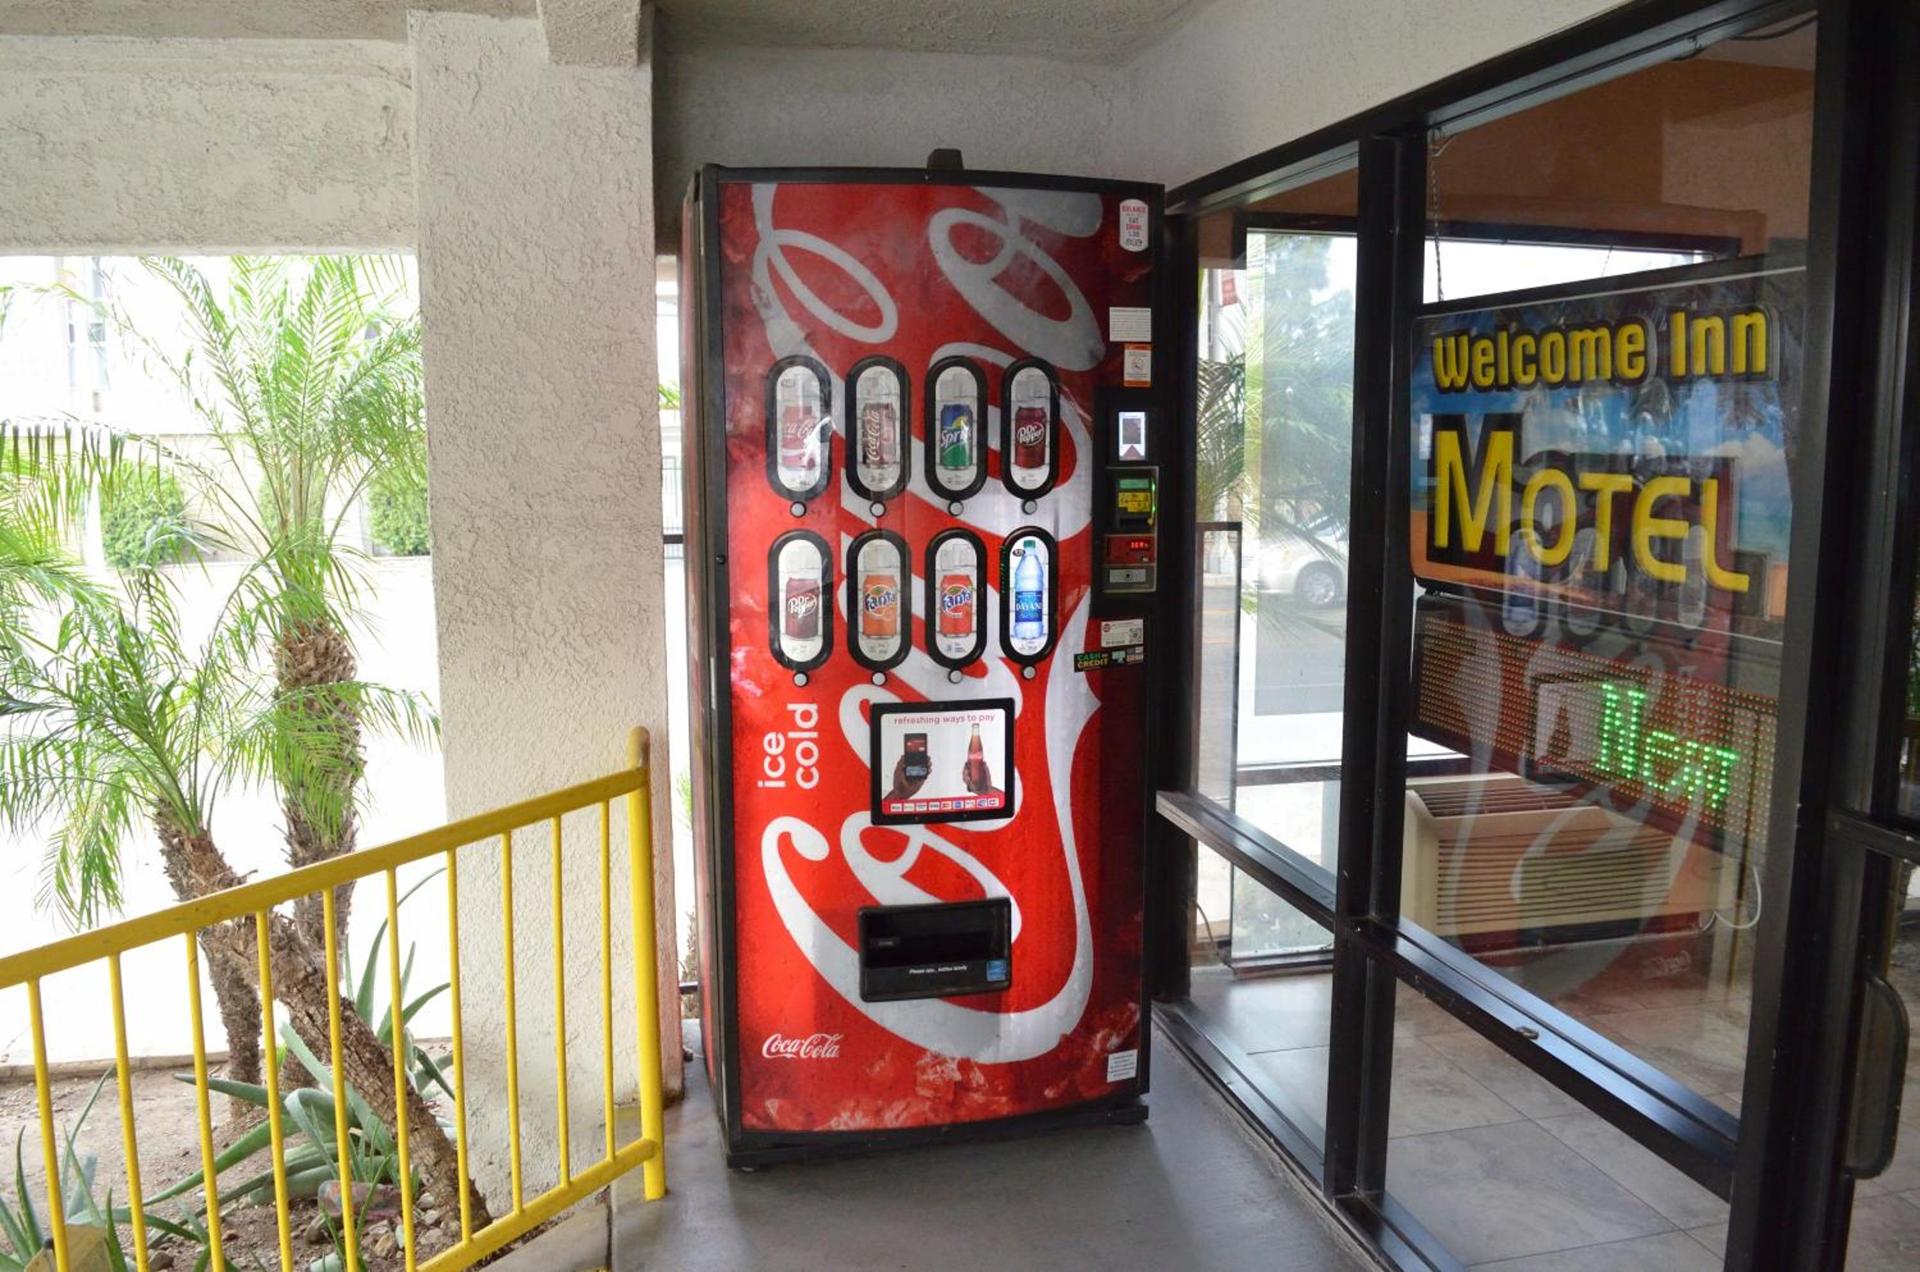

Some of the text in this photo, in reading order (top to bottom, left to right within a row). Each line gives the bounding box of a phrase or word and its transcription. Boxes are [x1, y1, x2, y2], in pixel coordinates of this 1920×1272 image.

[1432, 310, 1769, 390] Welcome Inn
[1433, 429, 1750, 593] MOTEL
[787, 703, 819, 790] cold
[894, 713, 996, 725] refreshing ways to pay
[757, 732, 786, 788] ice
[761, 1033, 844, 1059] Coca-Cola
